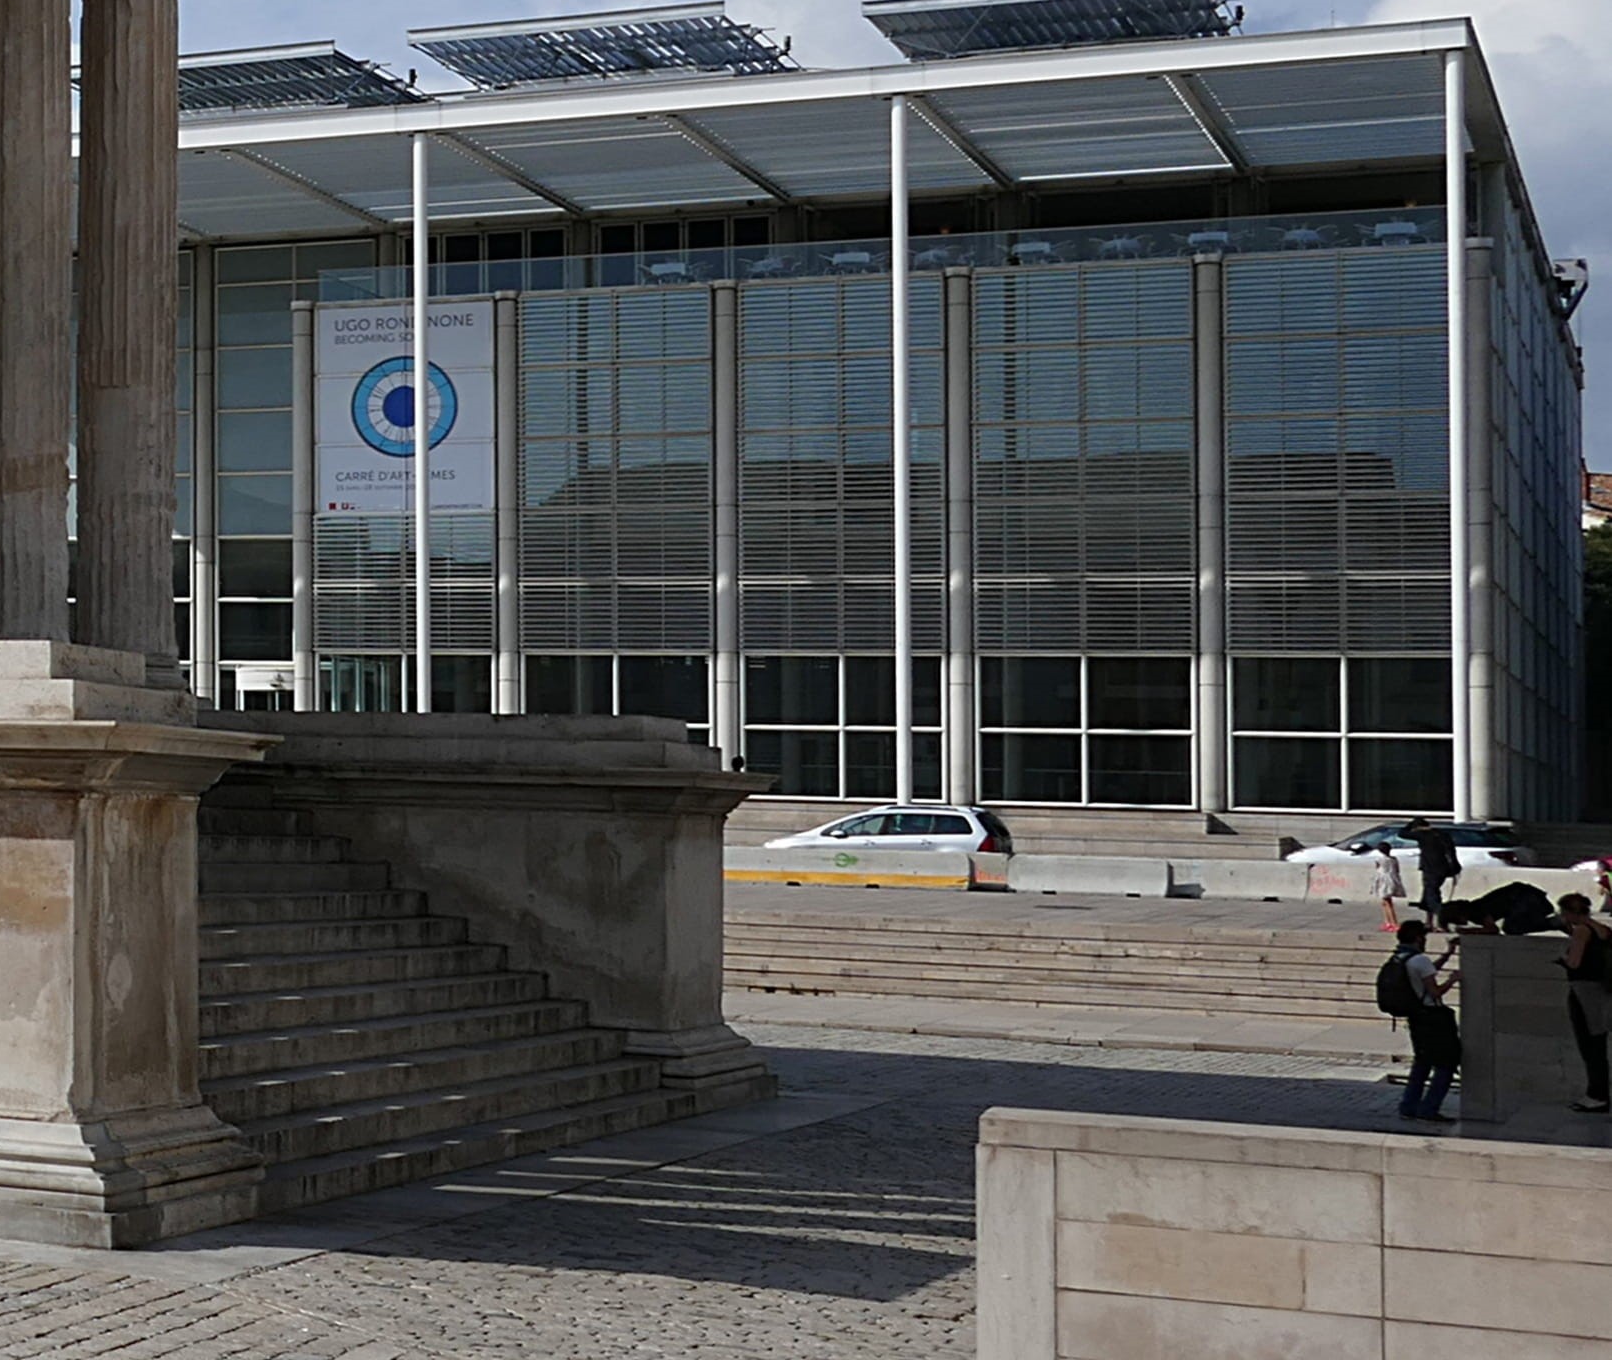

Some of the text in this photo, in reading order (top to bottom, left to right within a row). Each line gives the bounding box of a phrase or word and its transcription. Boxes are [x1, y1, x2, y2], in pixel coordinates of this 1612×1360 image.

[334, 313, 473, 332] UGO RONNONE
[334, 333, 396, 345] BECOMING
[335, 469, 374, 481] CARRÉ
